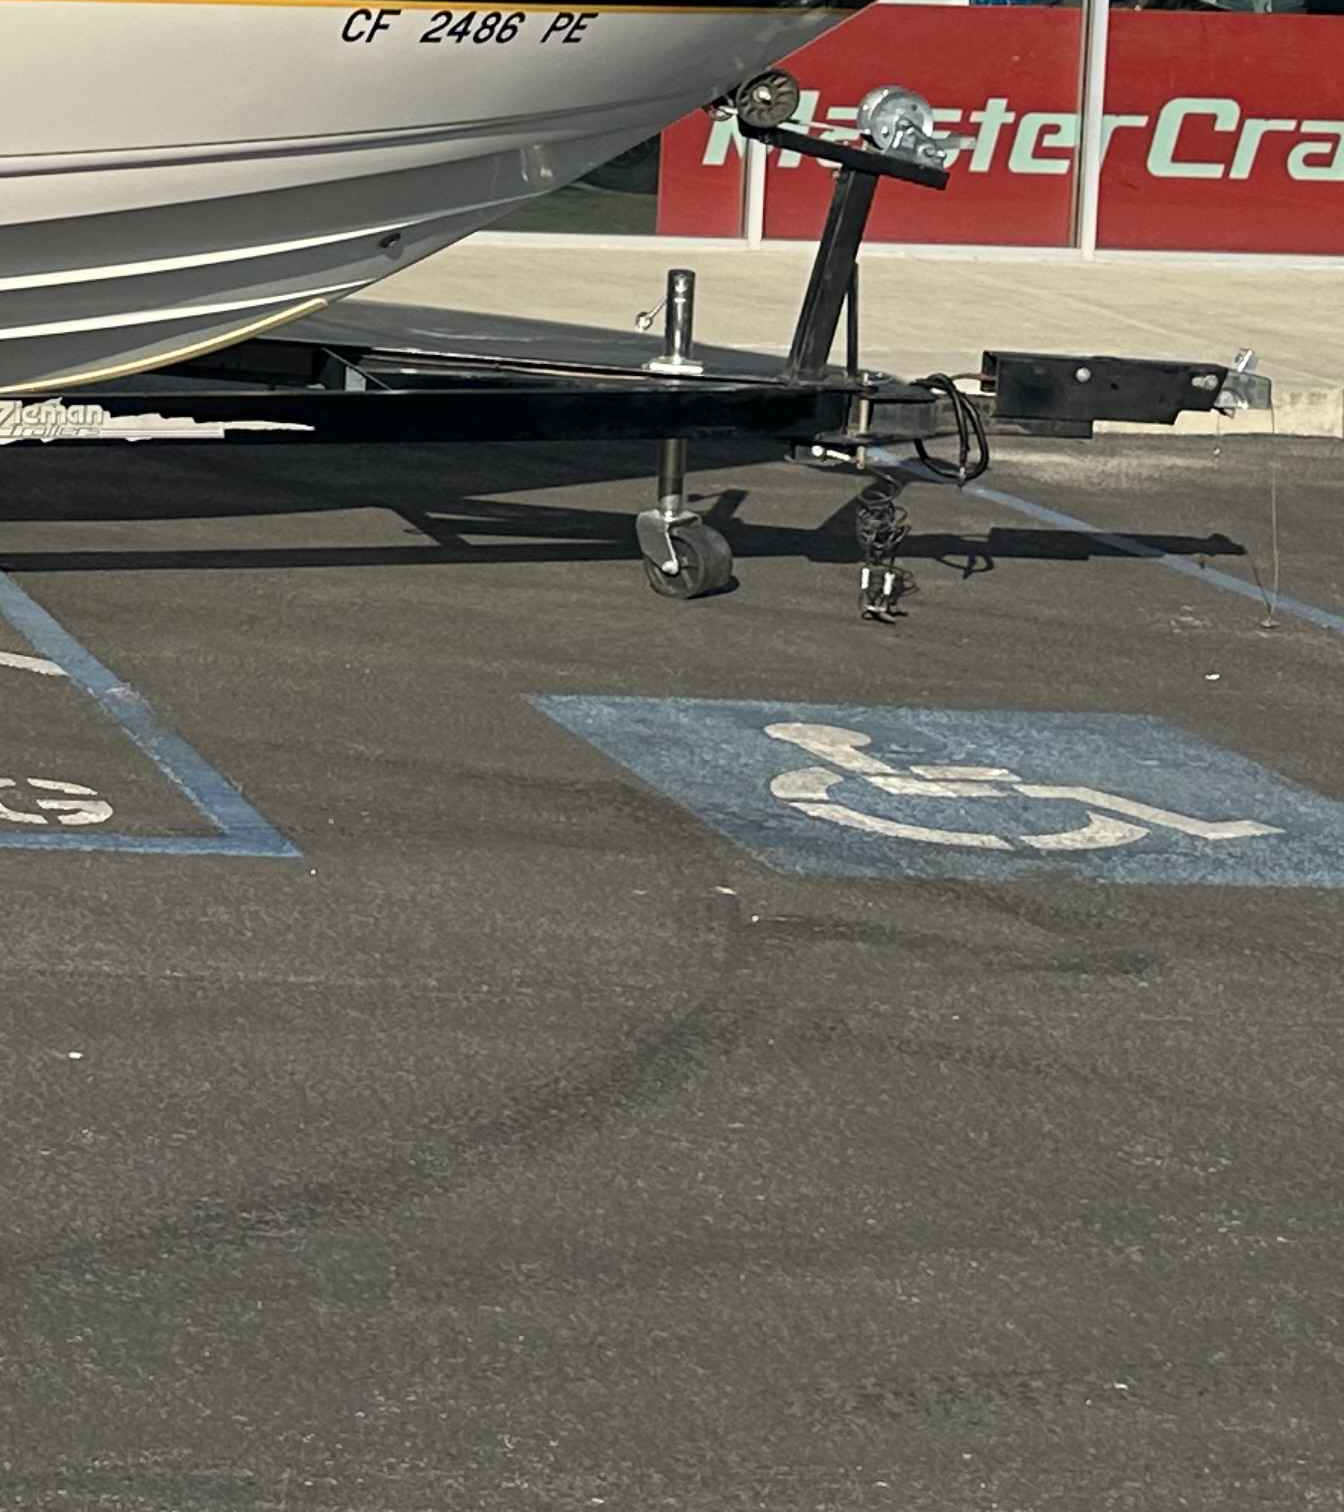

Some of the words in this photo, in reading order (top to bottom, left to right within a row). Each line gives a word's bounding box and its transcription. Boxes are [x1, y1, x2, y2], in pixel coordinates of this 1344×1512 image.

[342, 8, 402, 43] CF
[419, 10, 526, 44] 2486
[540, 12, 600, 44] PE
